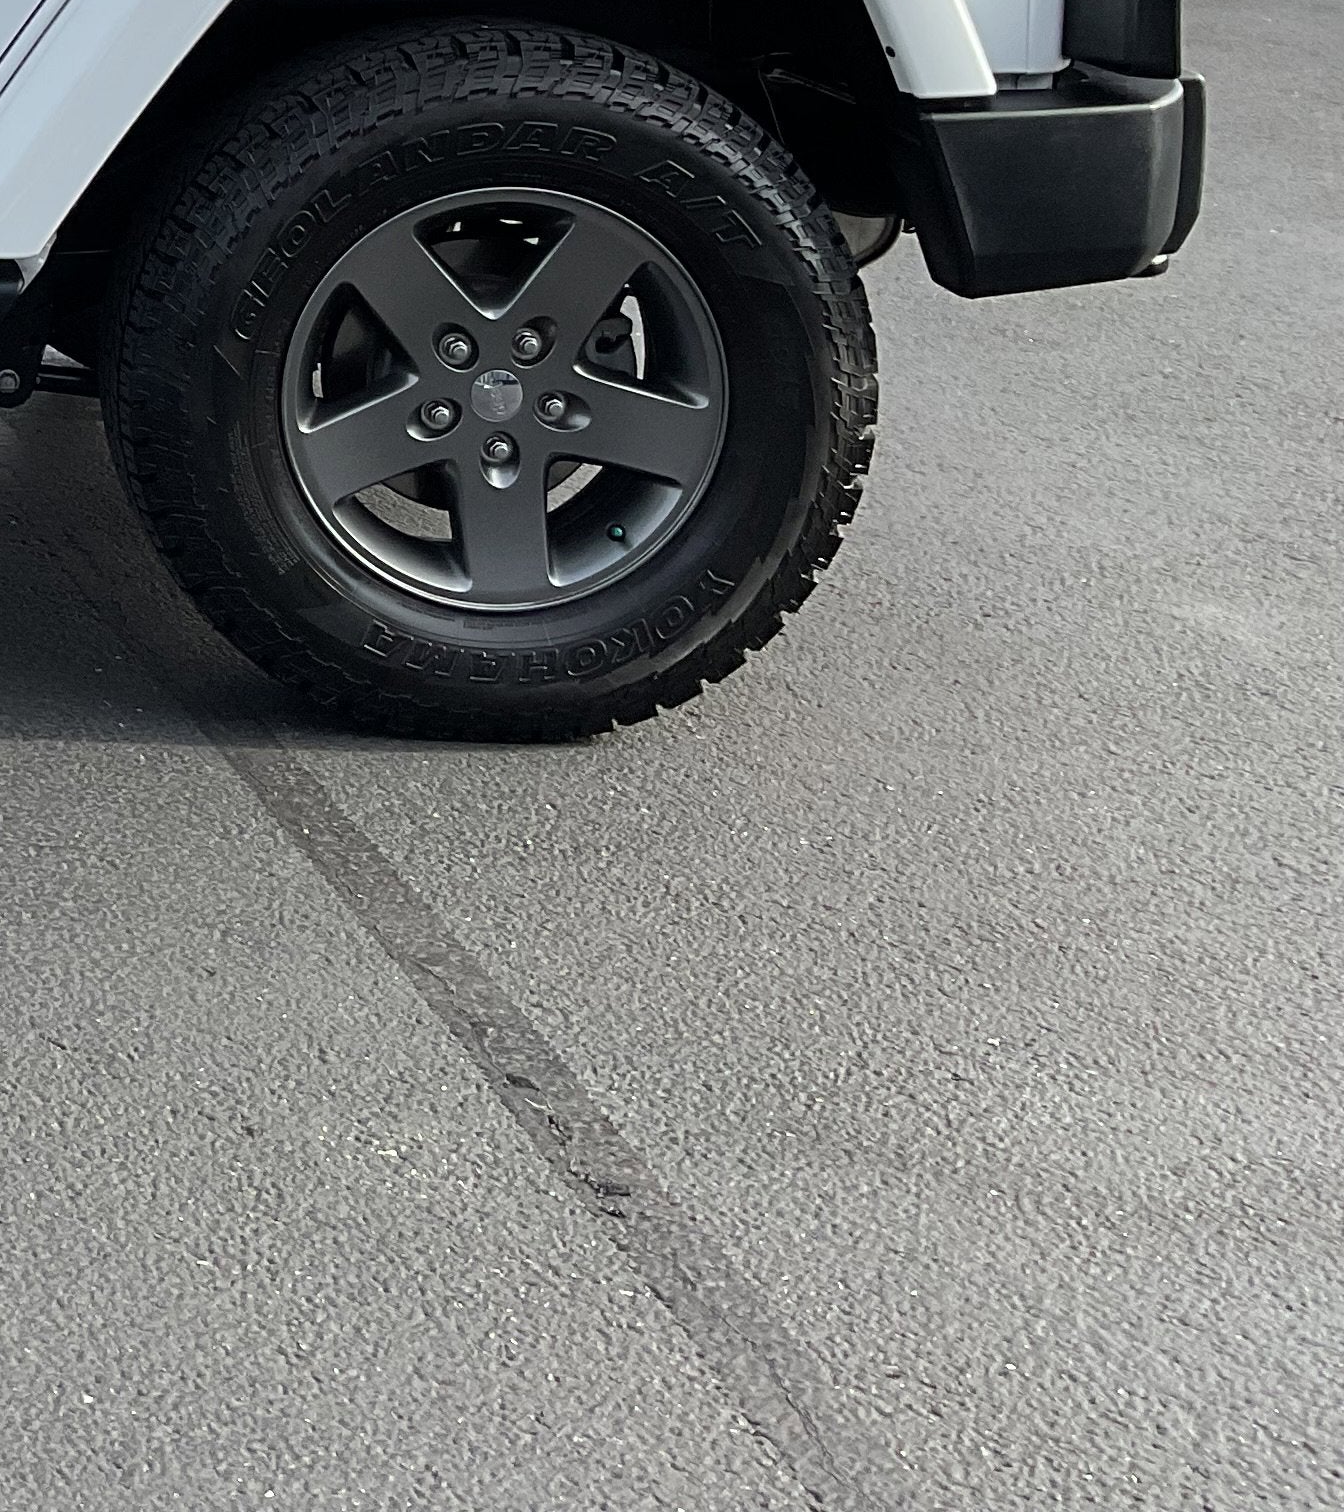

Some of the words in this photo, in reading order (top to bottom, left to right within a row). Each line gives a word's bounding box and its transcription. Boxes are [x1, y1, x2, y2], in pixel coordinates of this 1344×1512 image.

[233, 119, 618, 343] GEOLANDAR
[632, 158, 764, 251] A/T
[362, 567, 734, 686] YOKOHAMA
